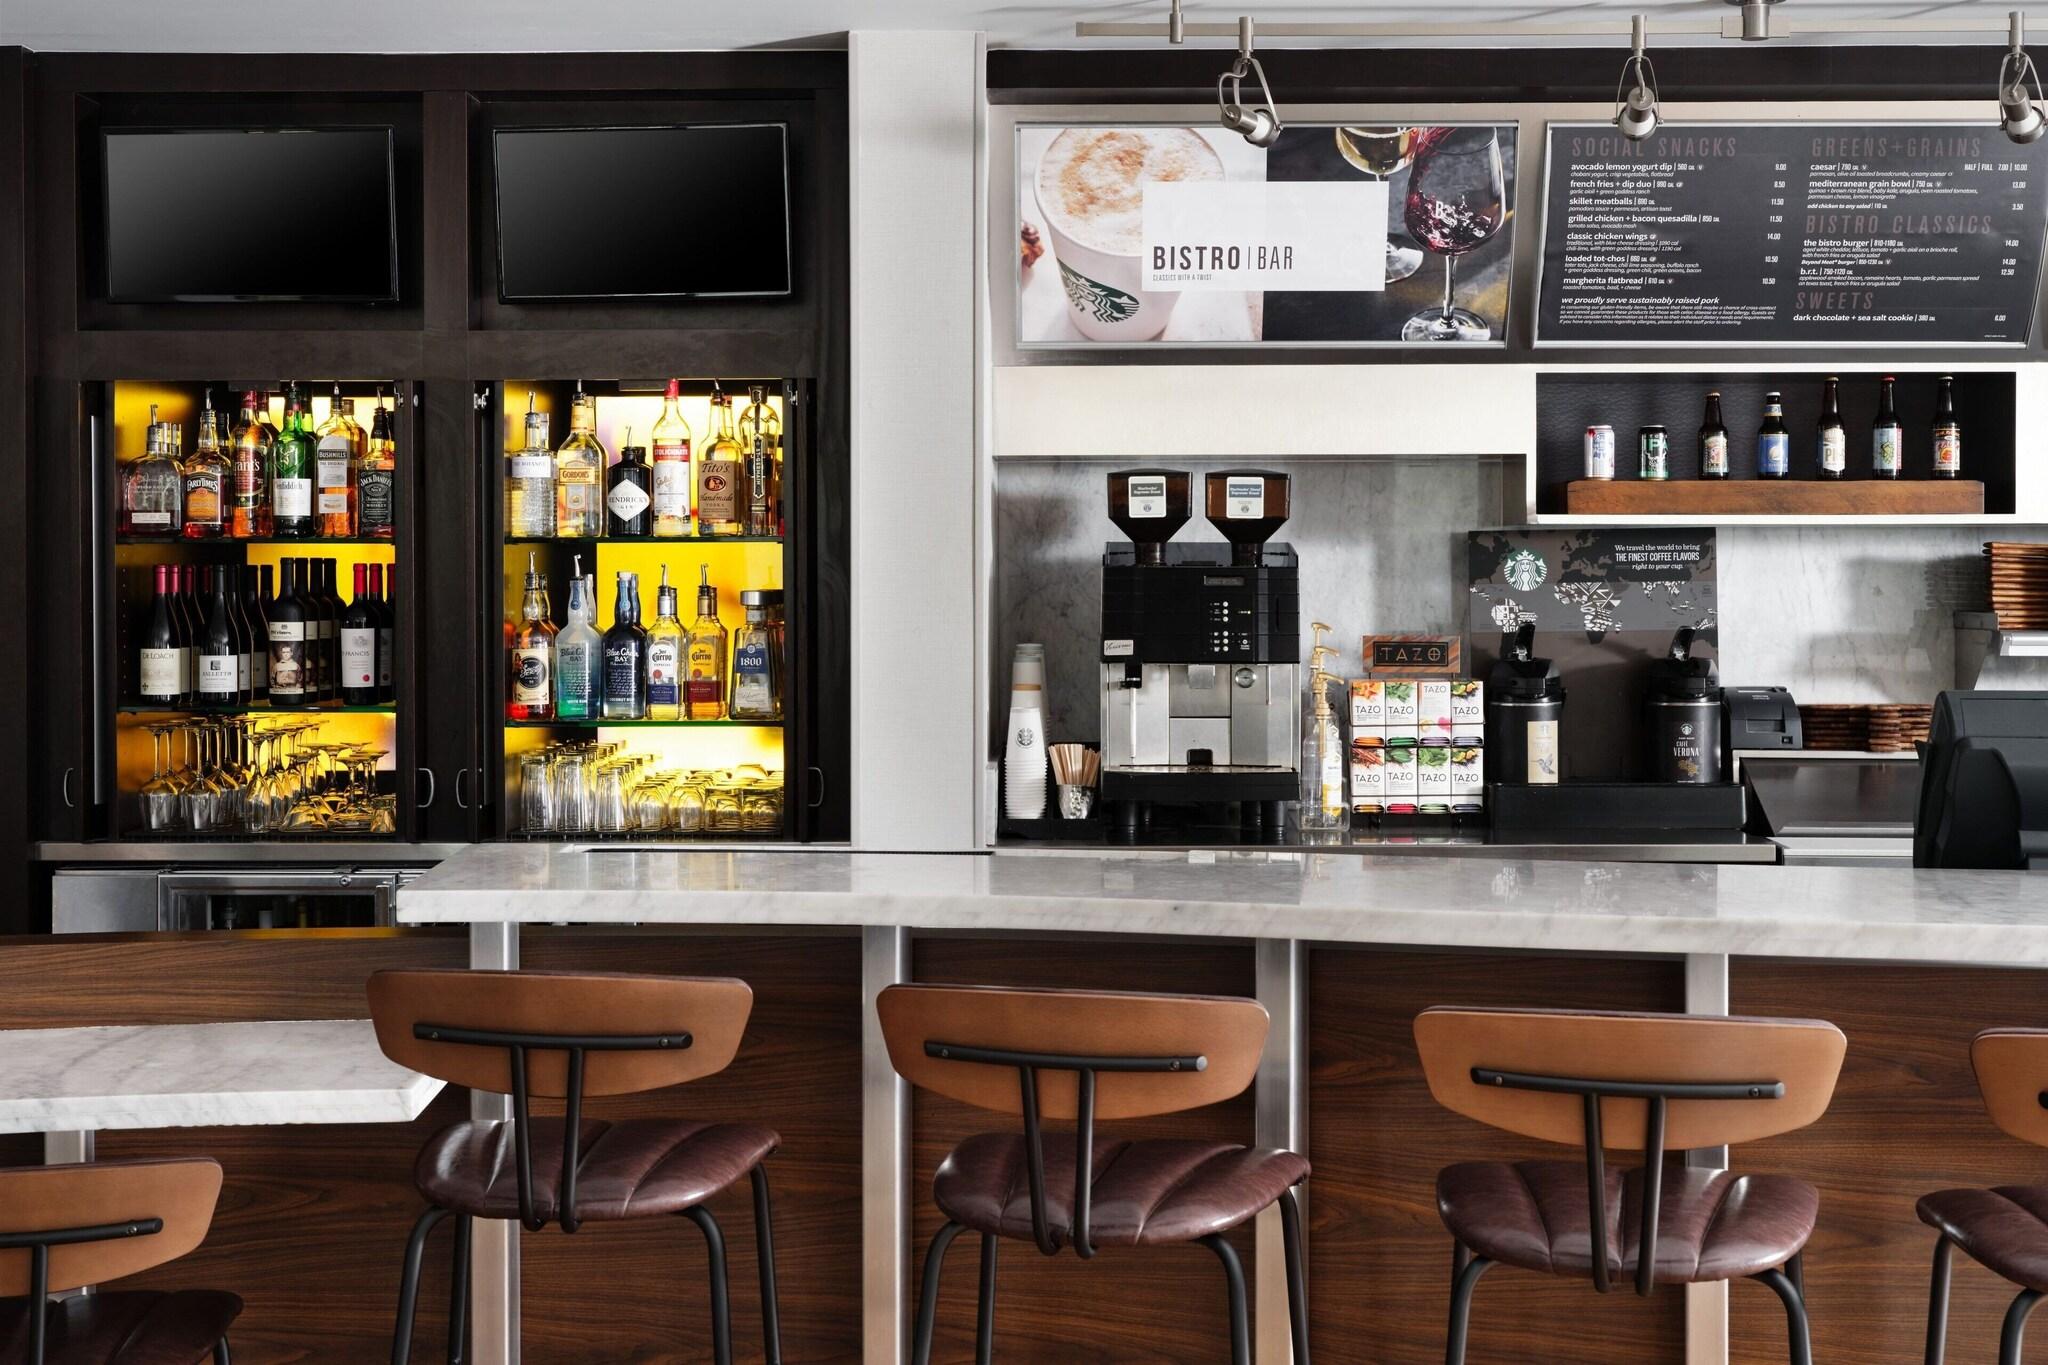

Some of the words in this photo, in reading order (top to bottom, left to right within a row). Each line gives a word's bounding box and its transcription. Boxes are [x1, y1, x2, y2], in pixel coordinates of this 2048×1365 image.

[1572, 138, 1644, 156] SOCIAL
[1658, 138, 1736, 157] SNACKS
[1632, 164, 1658, 172] yogurt
[1660, 163, 1672, 172] dip
[1622, 180, 1634, 188] dip
[1869, 180, 1889, 188] grain
[1568, 214, 1592, 223] grilled
[1658, 214, 1697, 223] quesadilla
[1806, 214, 1878, 233] BISTRO
[1893, 214, 1991, 234] CLASSICS
[1625, 232, 1648, 240] wings
[1804, 239, 1817, 248] the
[1818, 239, 1841, 248] bistro
[1843, 240, 1869, 248] burger
[1154, 246, 1240, 270] BISTRO
[1258, 246, 1292, 270] BAR
[1564, 277, 1606, 285] margherita
[1574, 296, 1605, 305] proudly
[1629, 297, 1674, 305] sustainably
[1700, 297, 1719, 305] pork
[1796, 292, 1873, 310] SWEETS
[234, 459, 260, 471] rant's
[702, 462, 730, 473] Tito's
[200, 478, 218, 491] TIMES
[361, 476, 372, 487] JACK
[1616, 553, 1627, 562] THE
[1628, 553, 1648, 561] FINEST
[1650, 552, 1672, 561] COFFEE
[1673, 552, 1699, 561] FLAVORS
[606, 648, 620, 656] Blue
[692, 652, 712, 661] Cuervo
[1381, 648, 1440, 661] TAZO
[652, 653, 672, 662] Cuervo
[741, 657, 762, 666] 1800
[1453, 707, 1479, 715] TAZO
[1674, 747, 1700, 756] VERONA
[1355, 774, 1380, 782] TAZO
[1388, 772, 1413, 780] TAZO
[1453, 774, 1478, 782] TAZO
